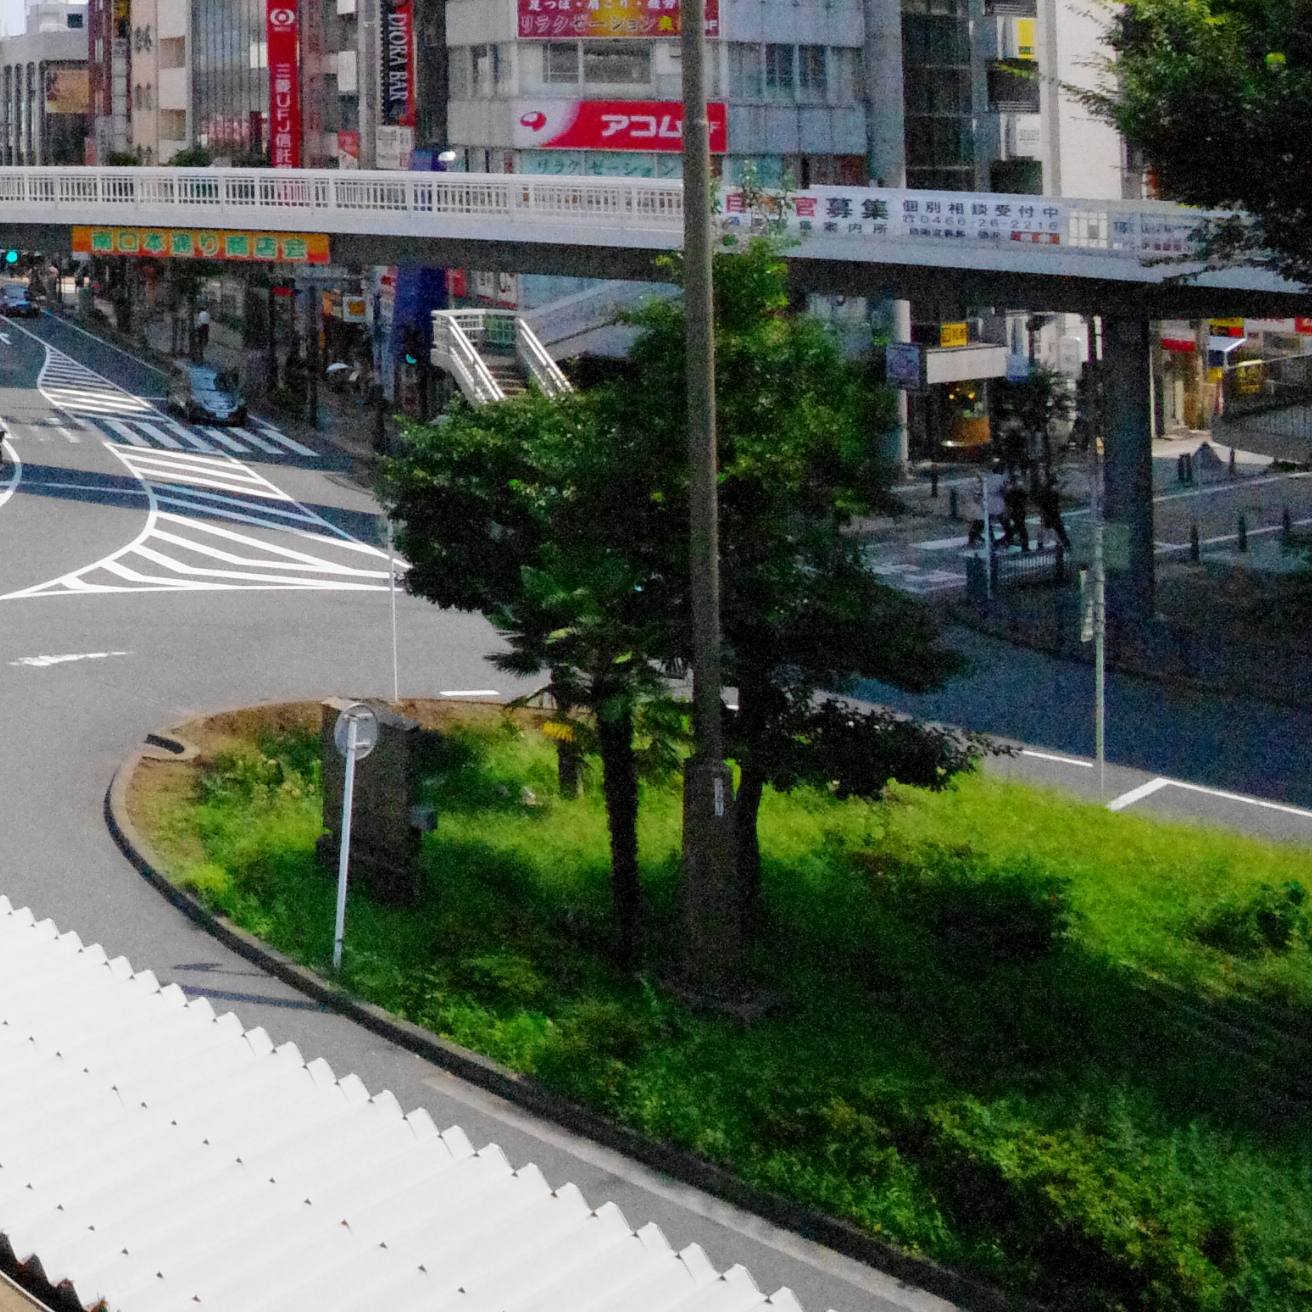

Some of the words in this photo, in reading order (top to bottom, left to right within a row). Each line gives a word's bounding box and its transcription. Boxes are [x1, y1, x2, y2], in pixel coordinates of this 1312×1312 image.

[388, 13, 408, 66] DIORA
[389, 70, 409, 101] BAR
[601, 115, 683, 138] アコム
[726, 194, 889, 220] 自官募集
[902, 200, 1059, 219] 個別相談受付中
[920, 215, 1059, 230] 0466-26-2216
[91, 229, 308, 260] 南口本通り商店会
